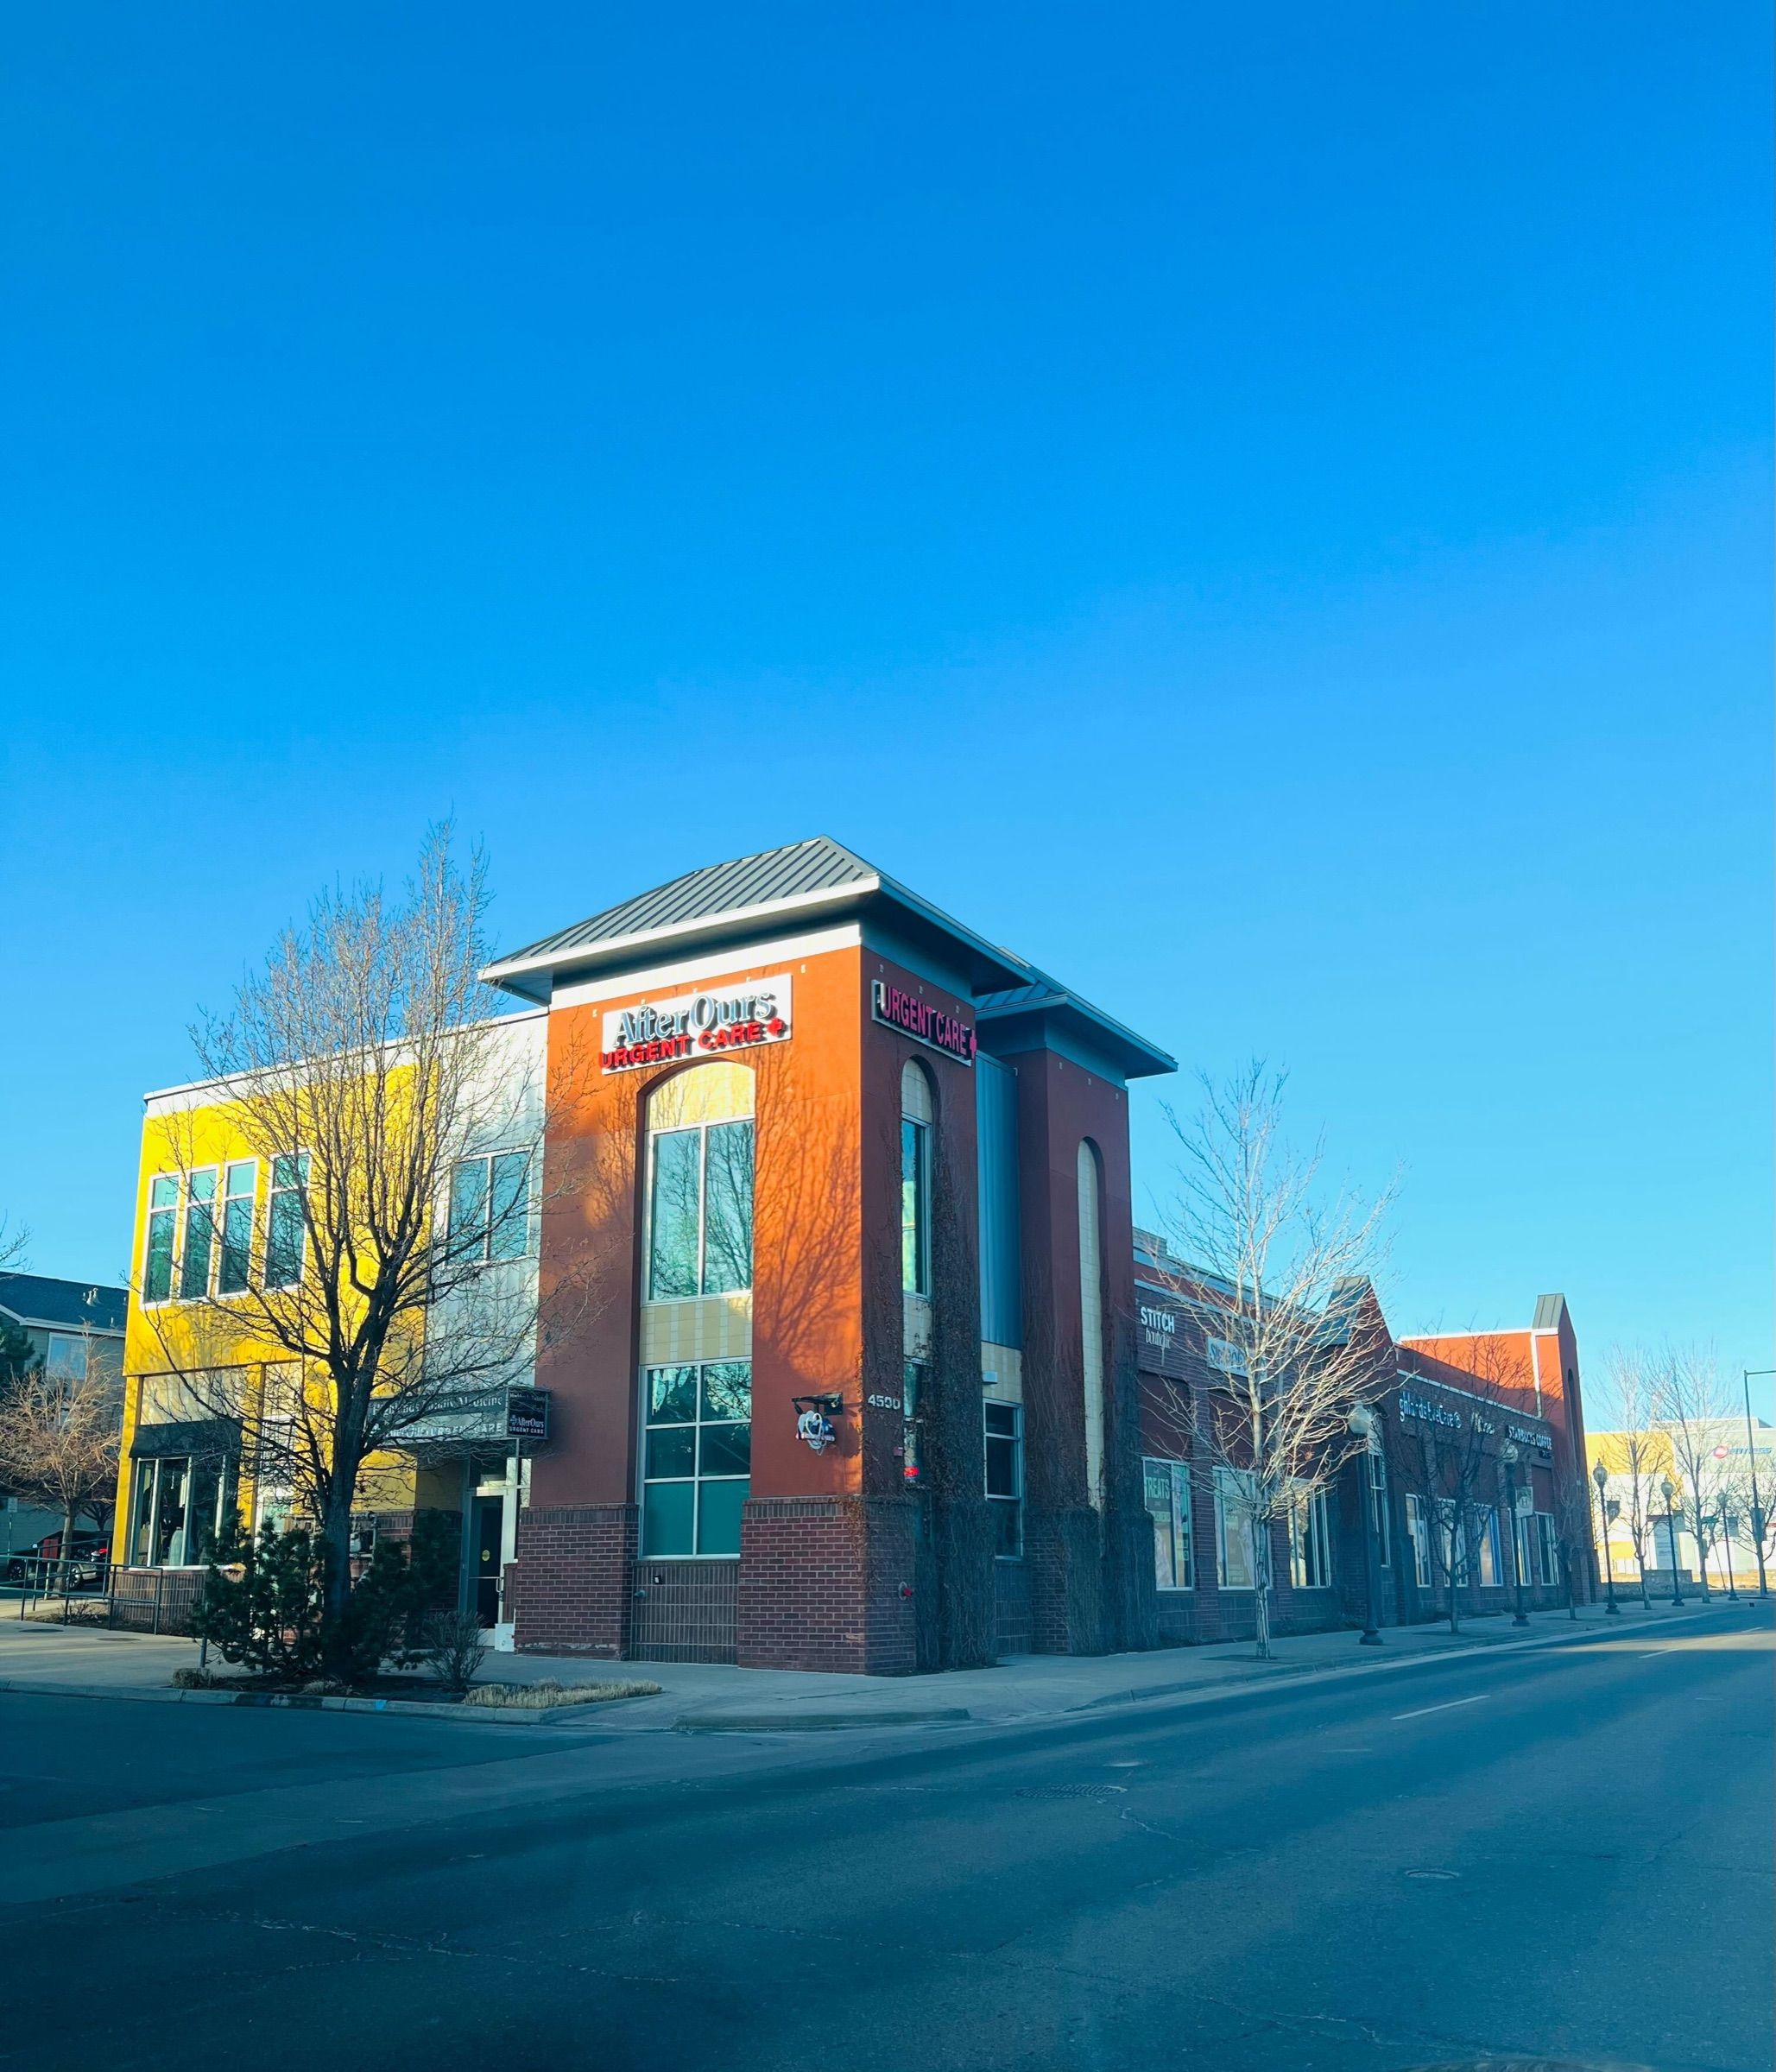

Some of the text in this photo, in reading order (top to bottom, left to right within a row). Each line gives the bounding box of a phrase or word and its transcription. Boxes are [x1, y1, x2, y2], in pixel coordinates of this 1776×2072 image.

[881, 982, 967, 1056] URGENT CARE
[598, 1021, 762, 1070] URGENT CARE
[1140, 1306, 1175, 1334] STITCH
[458, 1395, 503, 1408] Mdicine
[473, 1422, 503, 1434] CARE
